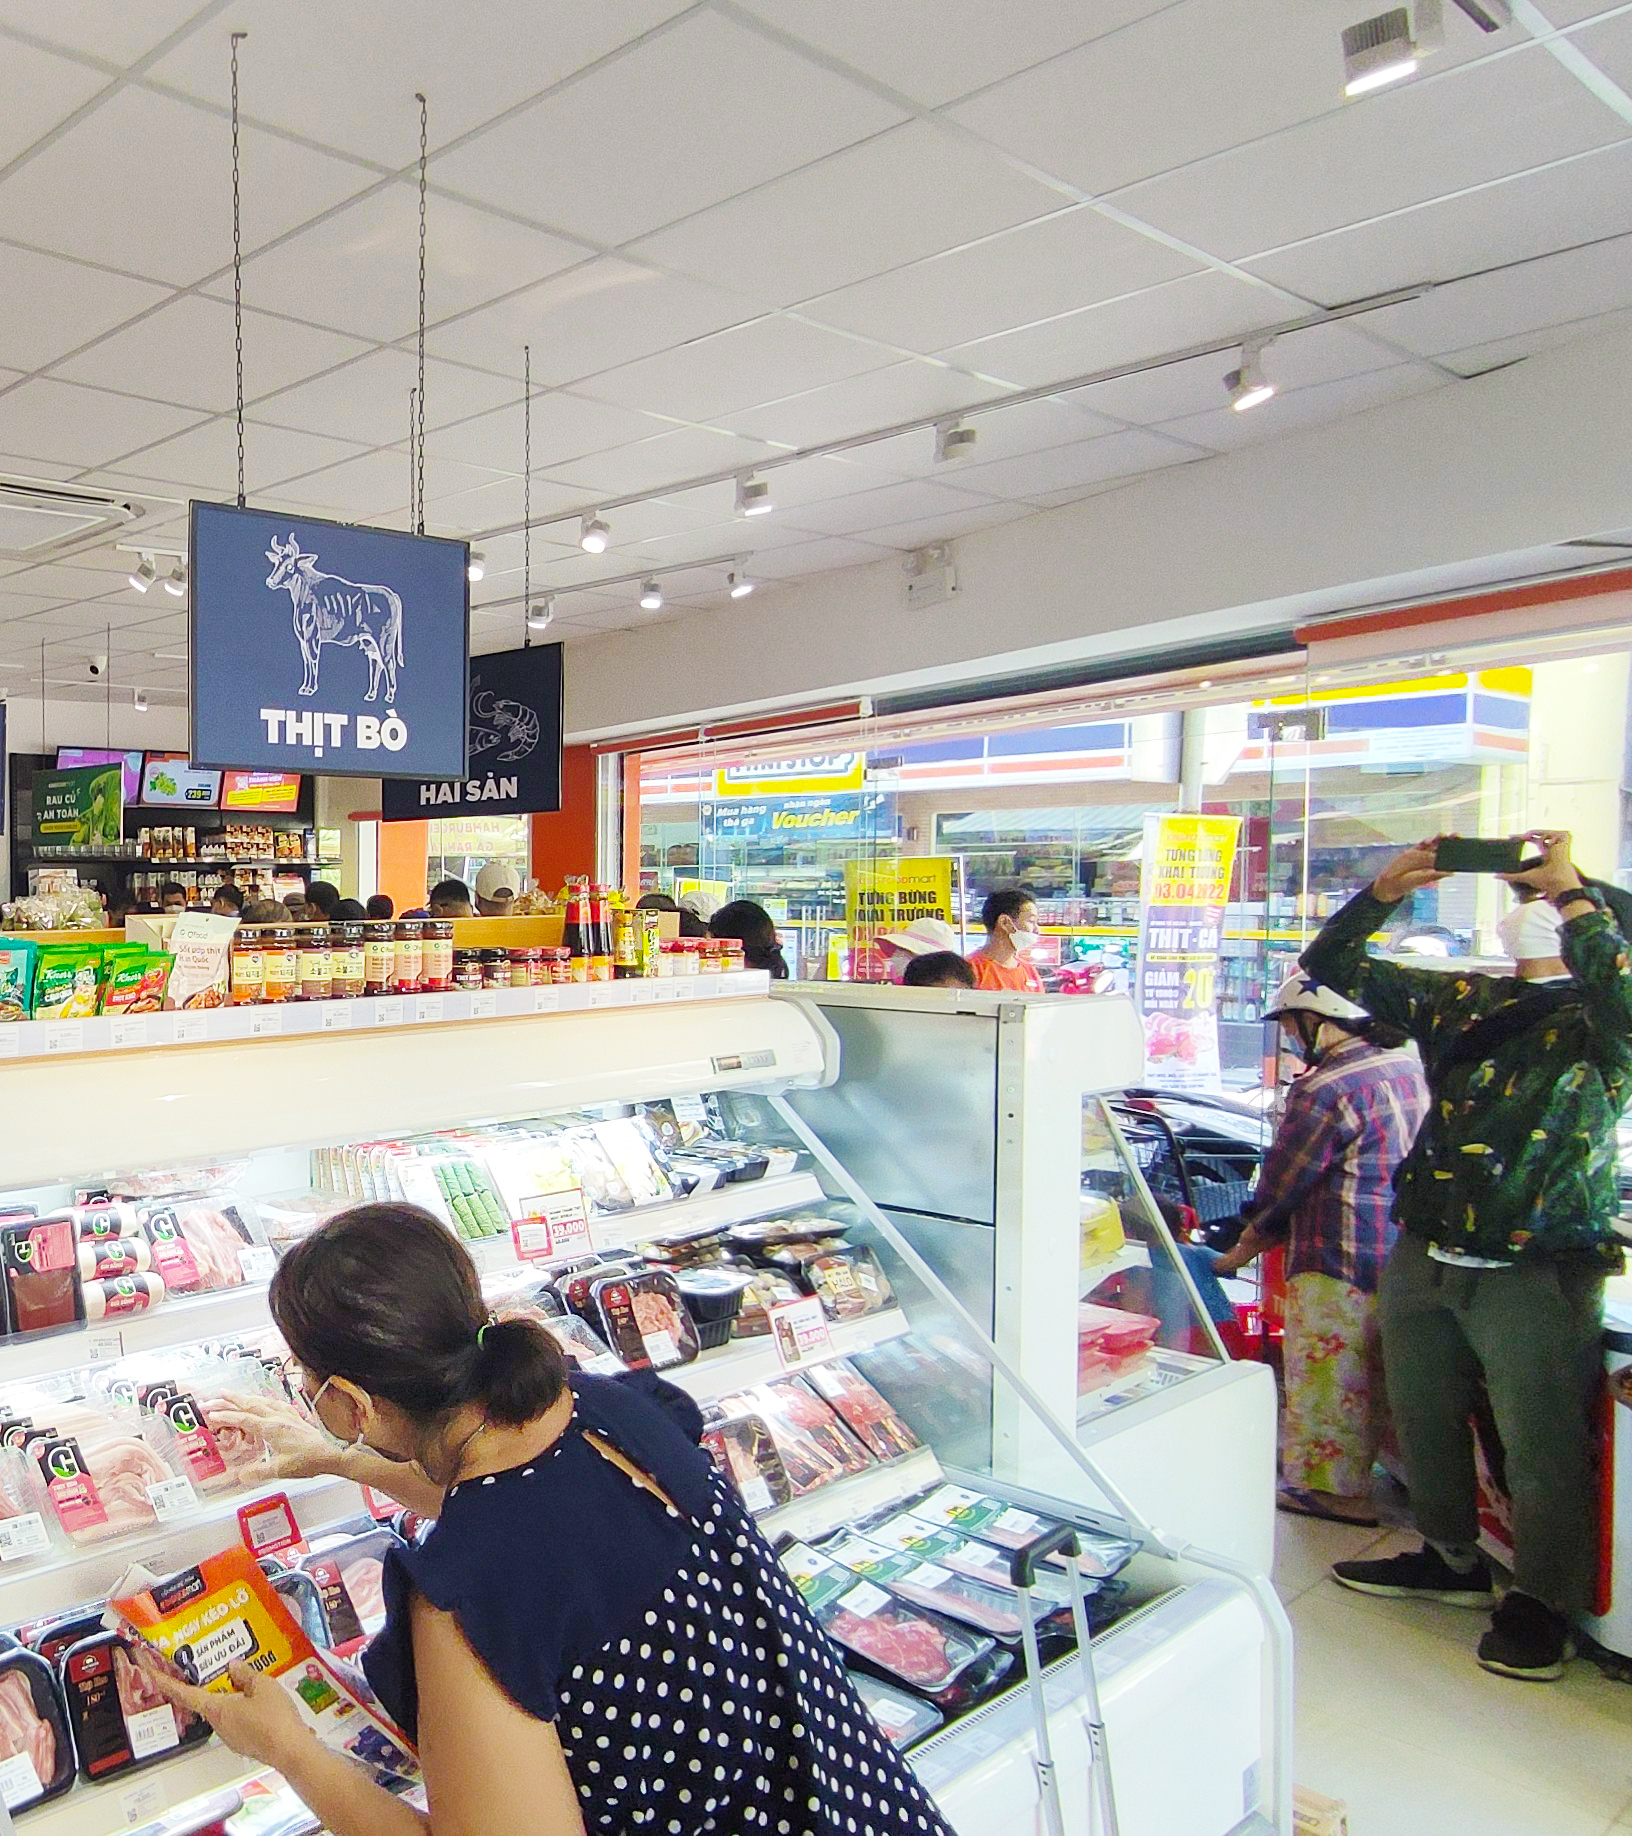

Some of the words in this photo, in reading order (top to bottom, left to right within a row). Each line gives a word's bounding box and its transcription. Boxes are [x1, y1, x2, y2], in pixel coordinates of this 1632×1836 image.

[260, 707, 348, 758] THỊT
[356, 708, 408, 752] BÒ
[465, 772, 518, 801] SẢN
[46, 796, 63, 805] RAU
[772, 808, 861, 830] Voucher
[117, 973, 142, 983] Knorr
[553, 1219, 585, 1236] 39.000
